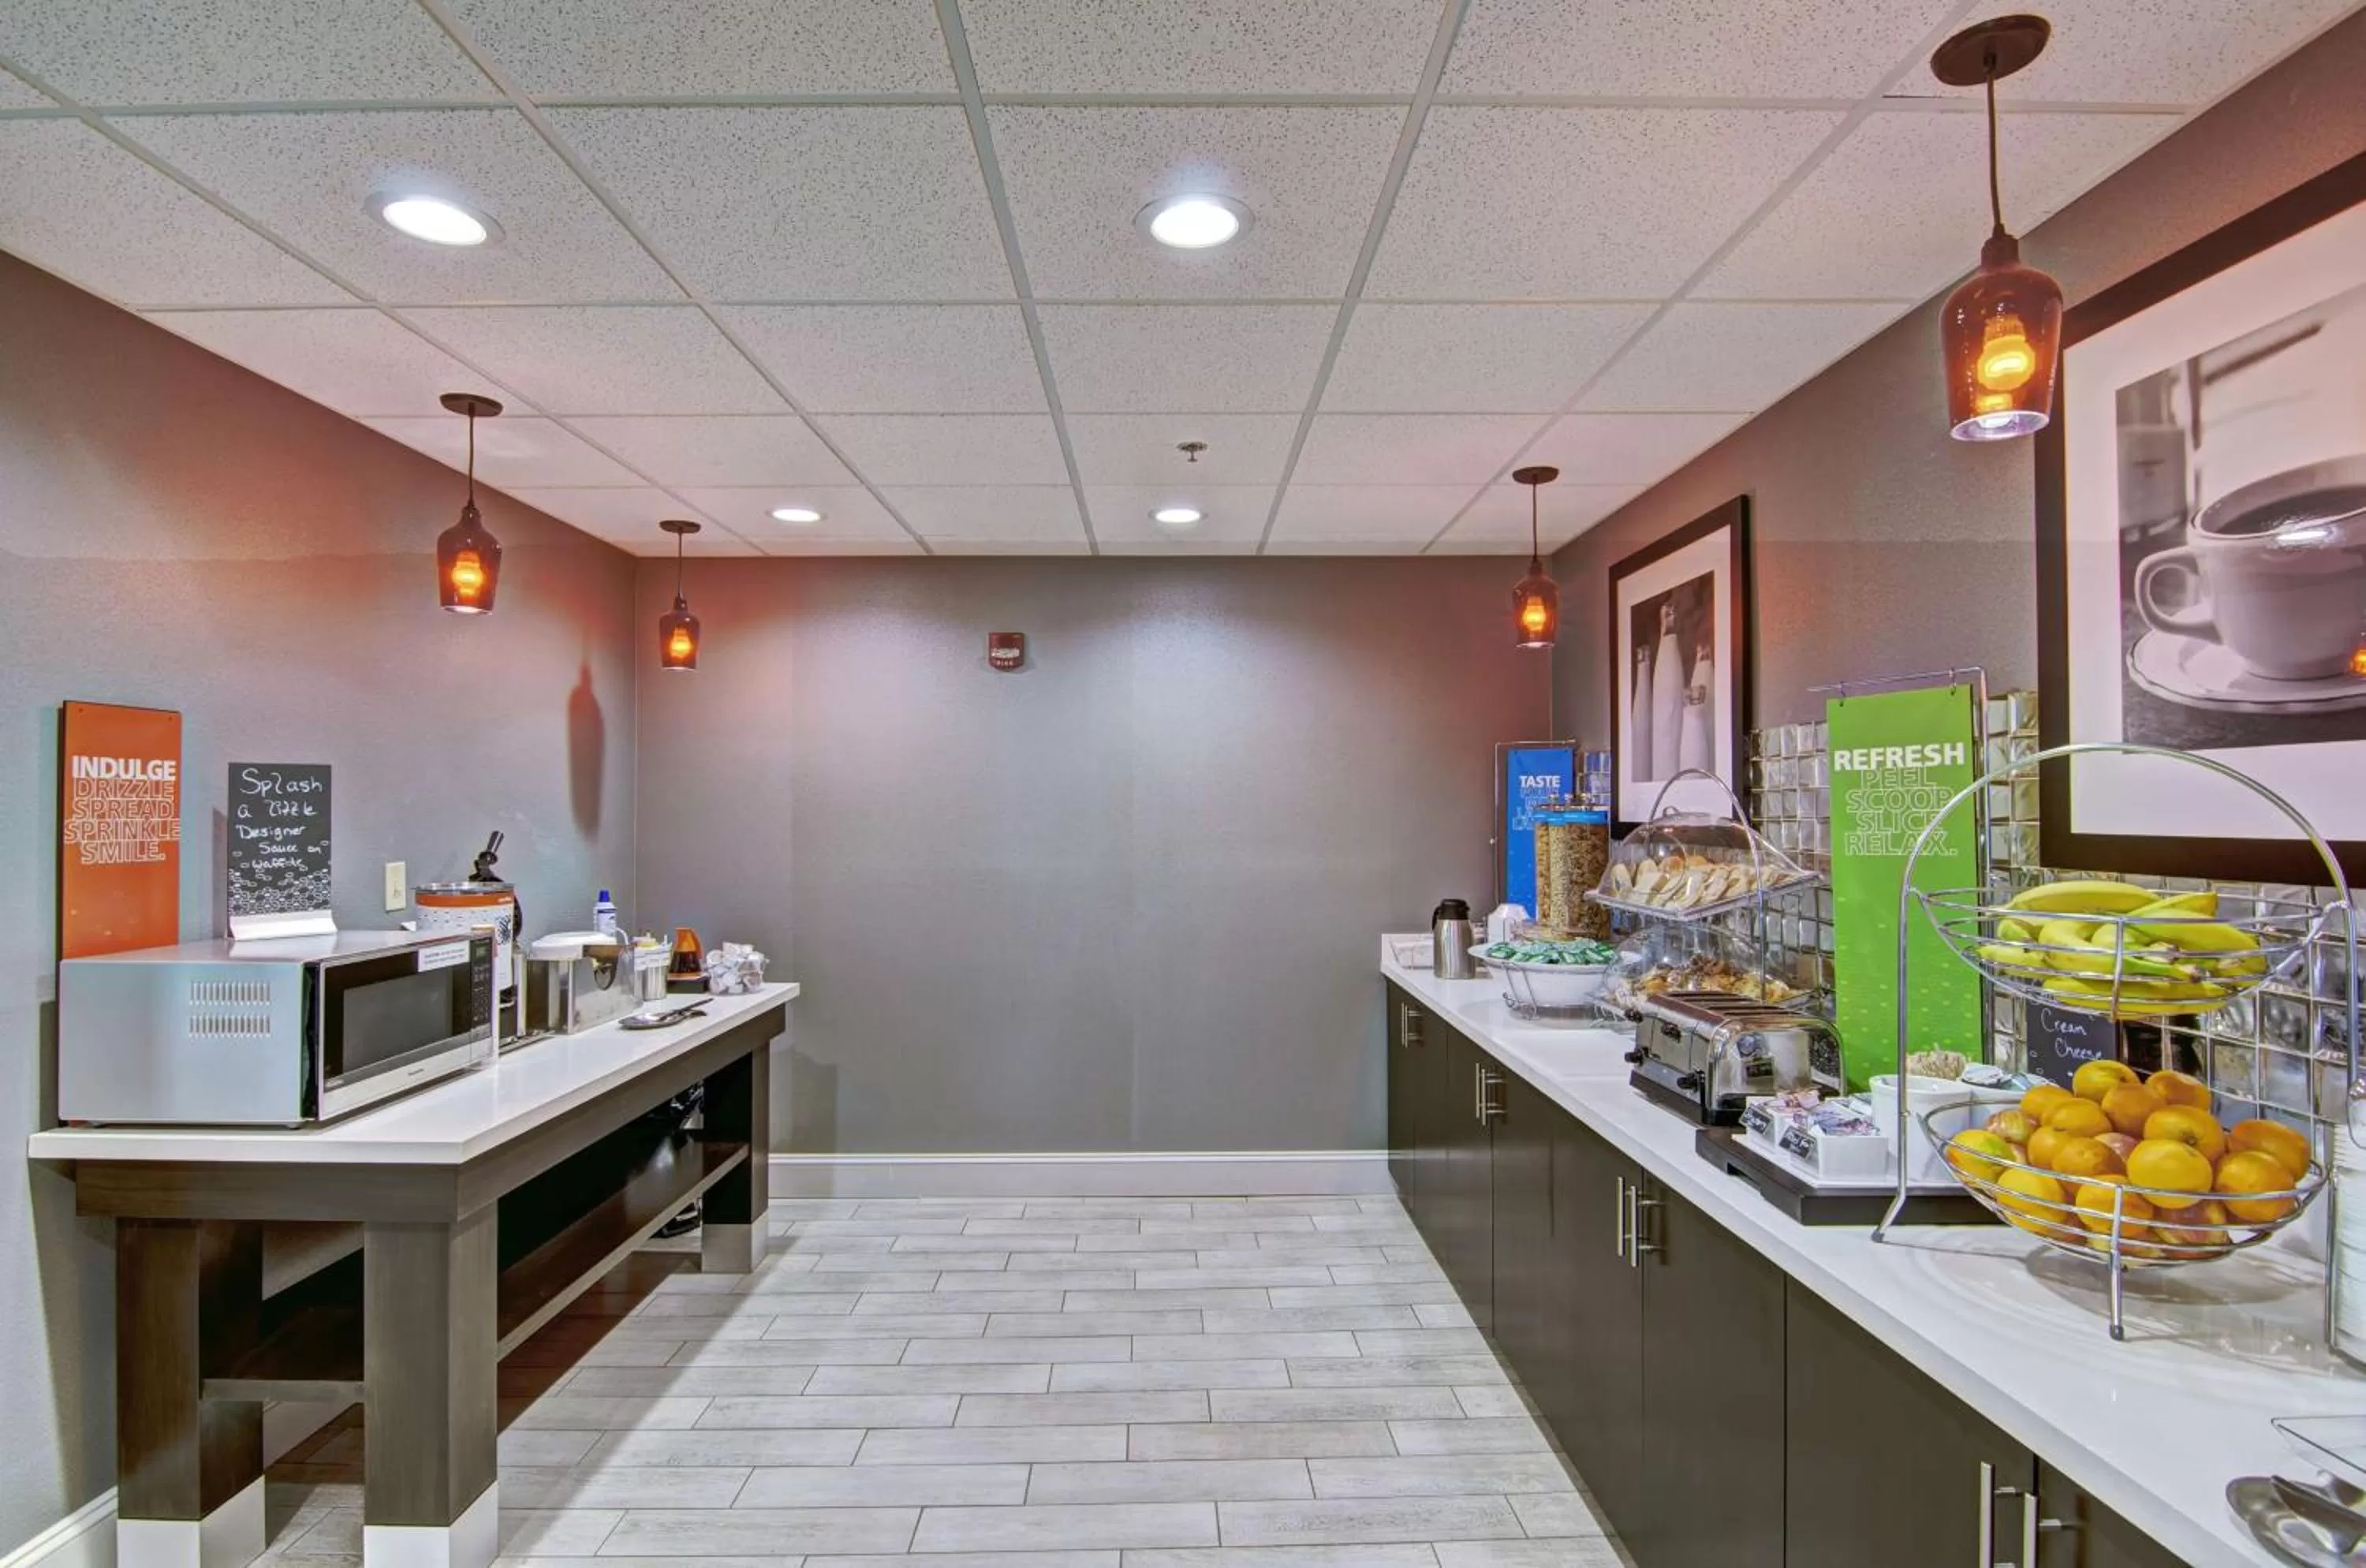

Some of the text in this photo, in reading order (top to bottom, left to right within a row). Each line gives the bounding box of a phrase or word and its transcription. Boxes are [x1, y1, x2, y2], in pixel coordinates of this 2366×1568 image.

[72, 755, 177, 781] INDULGE
[1833, 741, 1965, 771] REFRESH
[73, 777, 175, 800] DRIZZLE
[240, 767, 323, 797] Splash
[1519, 775, 1562, 788] TASTE
[1860, 766, 1937, 790] PEEL
[73, 797, 174, 821] SPREAD
[237, 804, 252, 818] a
[1845, 787, 1954, 813] SCOOP
[64, 818, 181, 845] SPRINKLE
[235, 824, 307, 842] Designer
[1845, 831, 1959, 856] RELAX.
[81, 839, 166, 865] SMILE.
[2040, 1007, 2087, 1036] Cream
